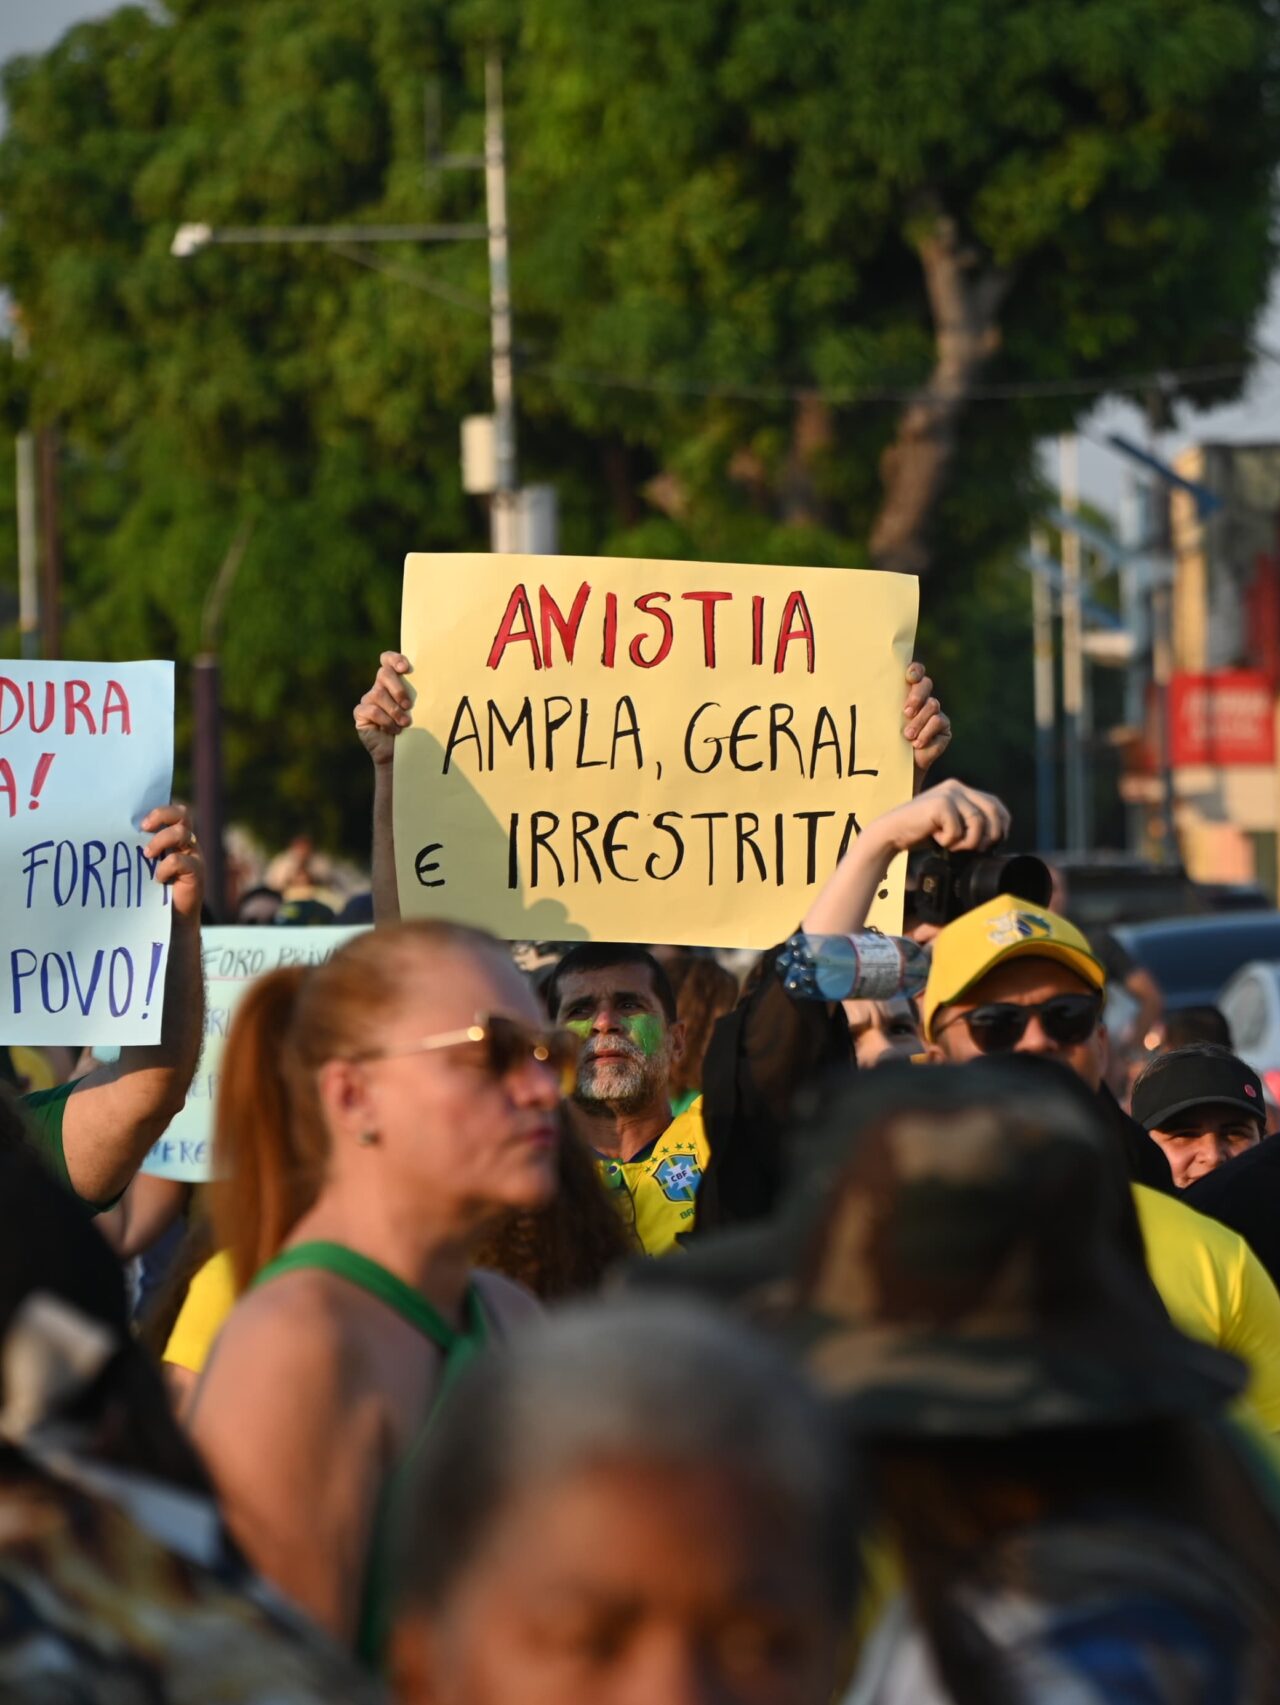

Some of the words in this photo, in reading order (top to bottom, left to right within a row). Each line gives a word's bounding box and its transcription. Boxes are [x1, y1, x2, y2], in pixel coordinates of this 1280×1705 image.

[486, 581, 815, 674] ANISTIA
[442, 695, 663, 781] AMPLA,
[684, 702, 879, 780] GERAL
[22, 840, 169, 908] FORAM
[11, 942, 164, 1020] POVO!
[671, 1170, 688, 1182] CBF
